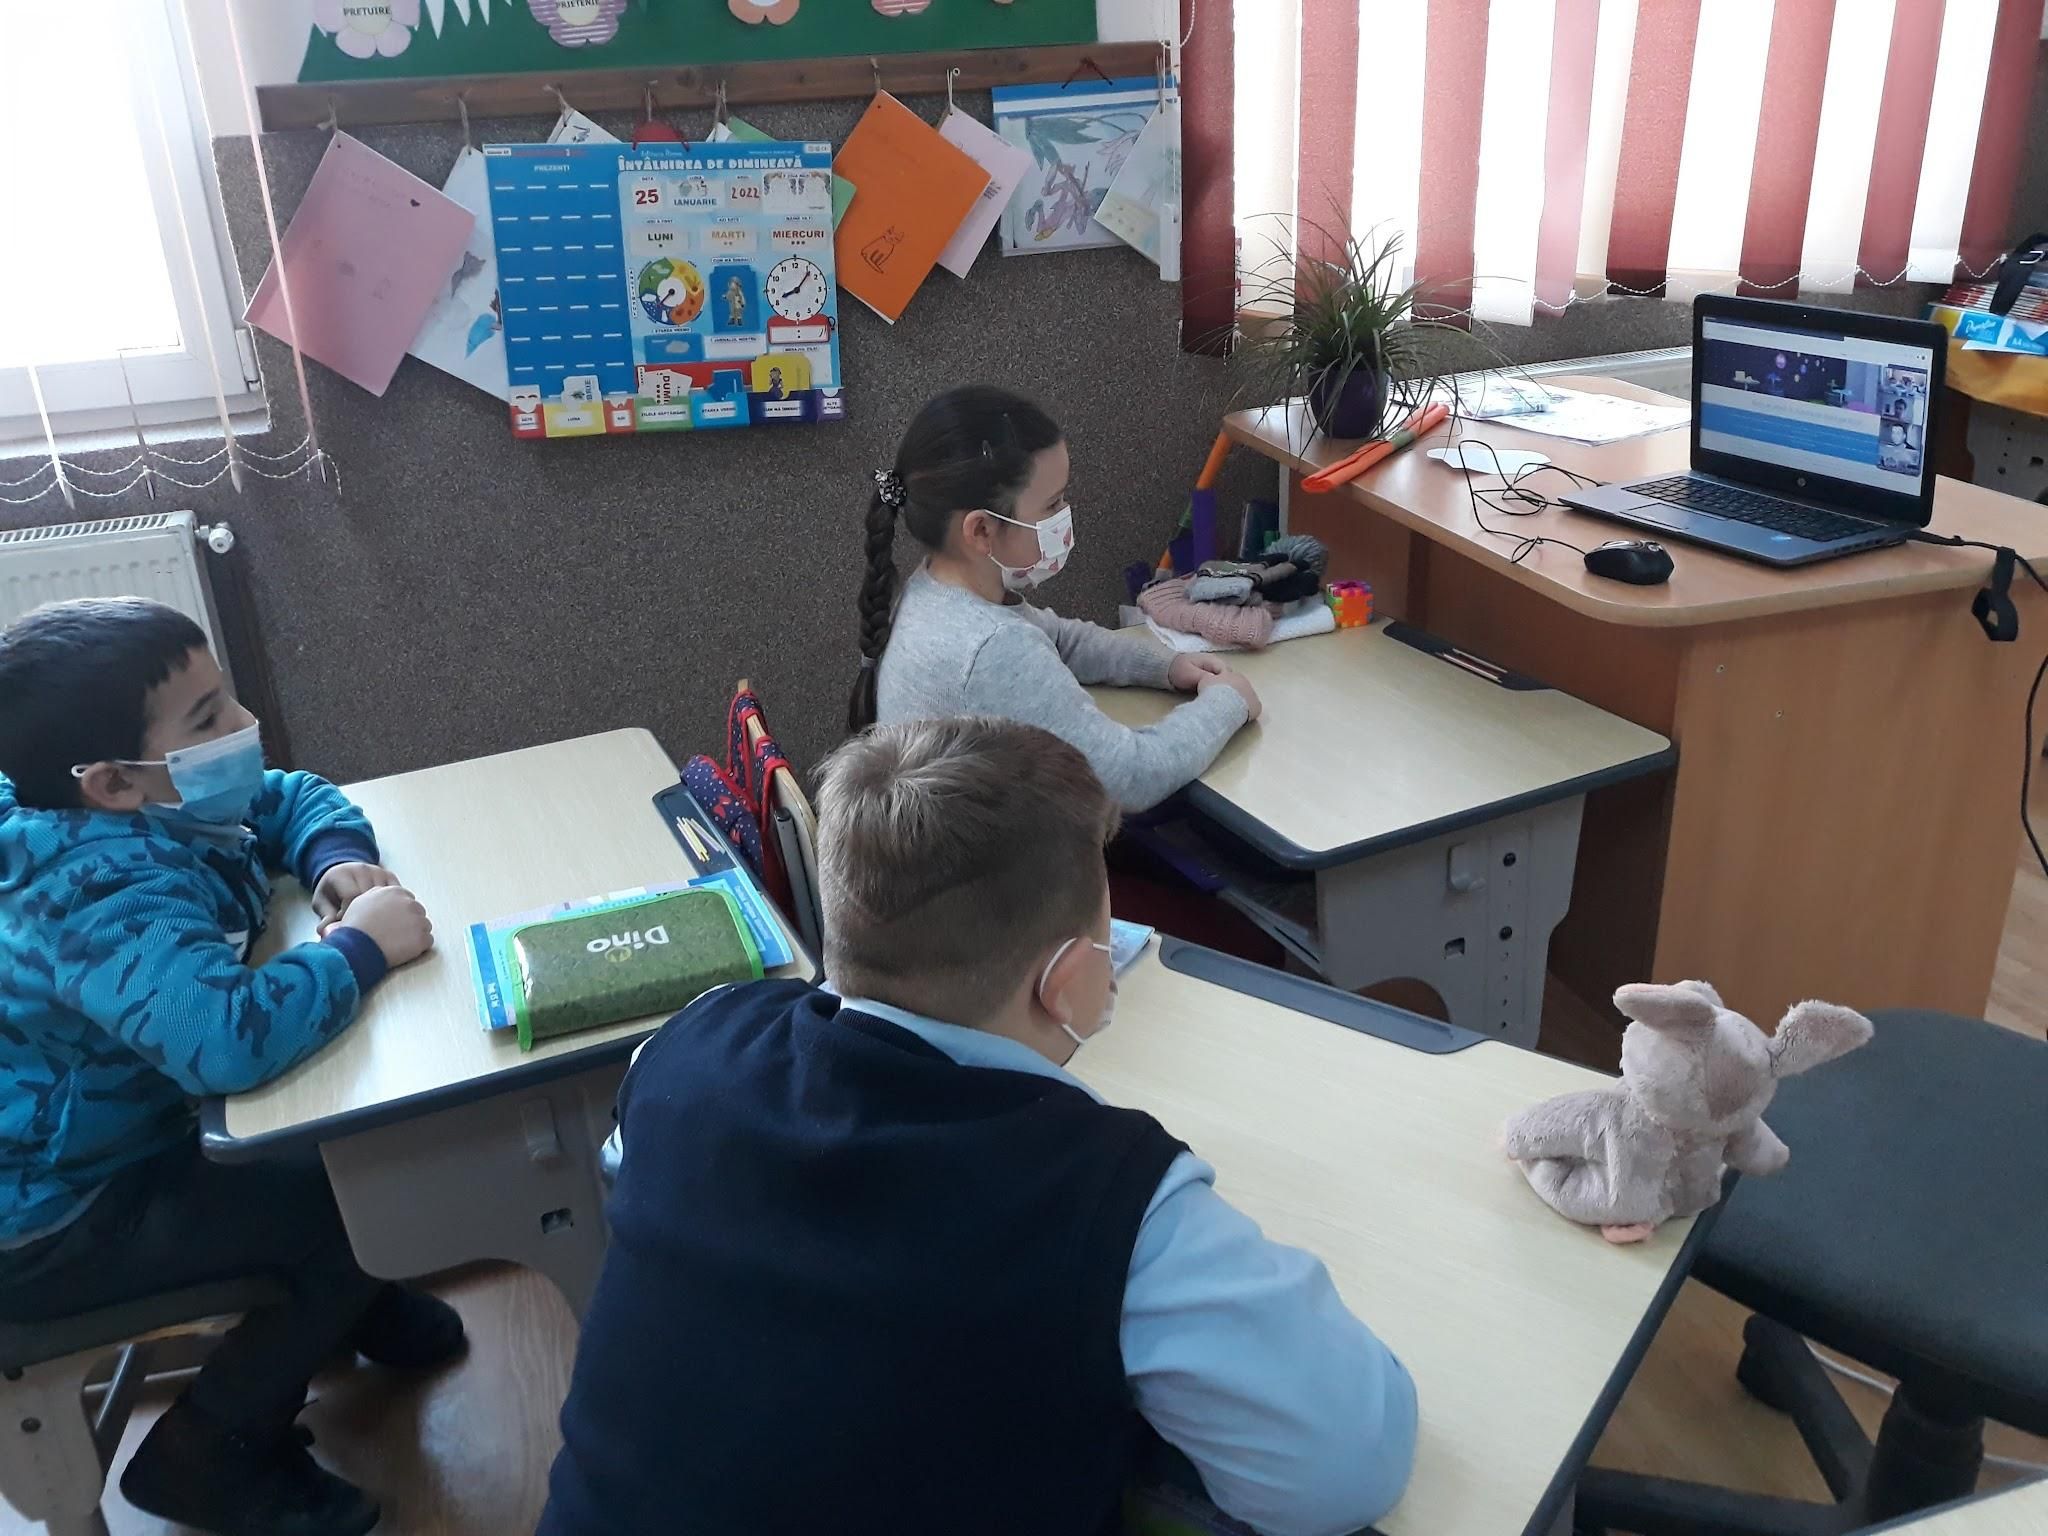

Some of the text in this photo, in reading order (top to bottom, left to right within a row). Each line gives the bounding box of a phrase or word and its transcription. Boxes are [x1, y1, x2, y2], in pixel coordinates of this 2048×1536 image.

[617, 154, 703, 171] ÎNTÂLNIREA
[707, 159, 724, 170] DE
[635, 189, 659, 205] 25
[731, 187, 760, 199] 2022
[647, 233, 673, 241] LUNI
[773, 230, 824, 238] MIERCURI
[586, 925, 669, 952] Dino
